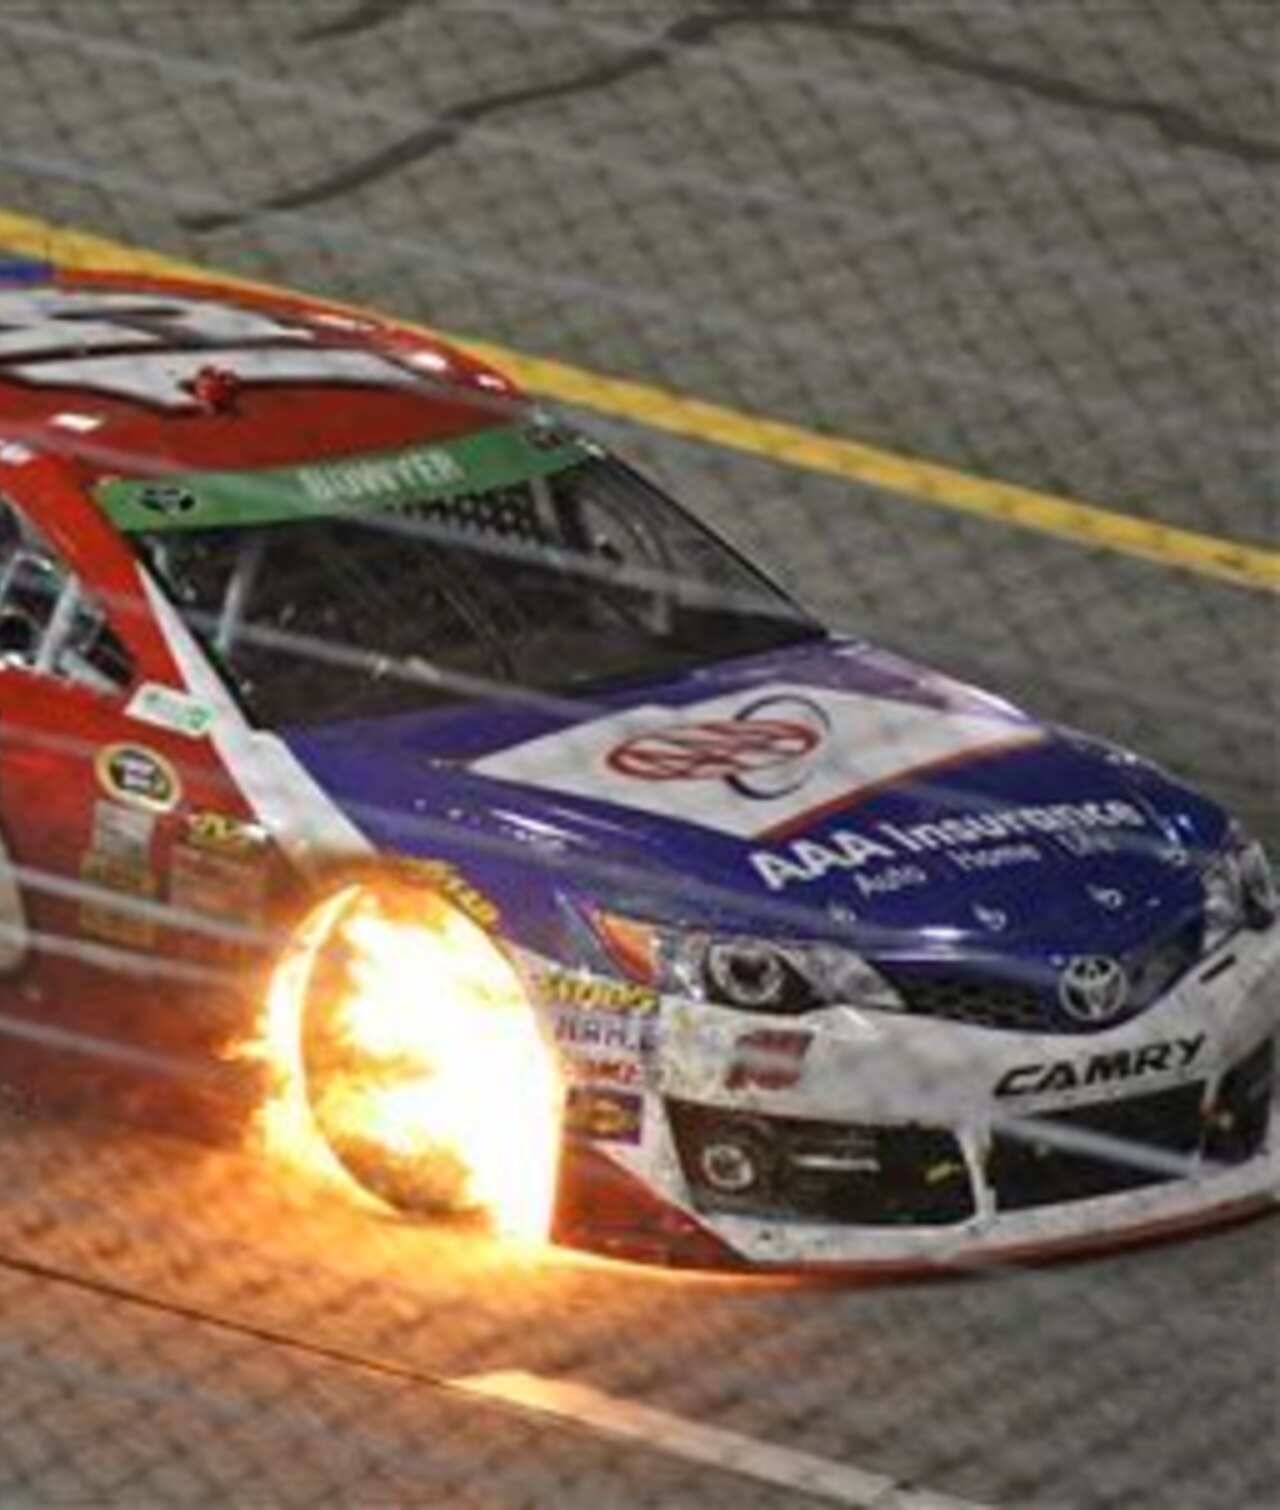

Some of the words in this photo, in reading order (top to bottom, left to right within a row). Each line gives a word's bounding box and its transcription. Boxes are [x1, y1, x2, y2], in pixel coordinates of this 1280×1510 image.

[298, 447, 466, 503] BOWYER
[749, 829, 895, 892] AAA
[878, 799, 1145, 852] Insurance
[992, 1028, 1207, 1098] CAMRY
